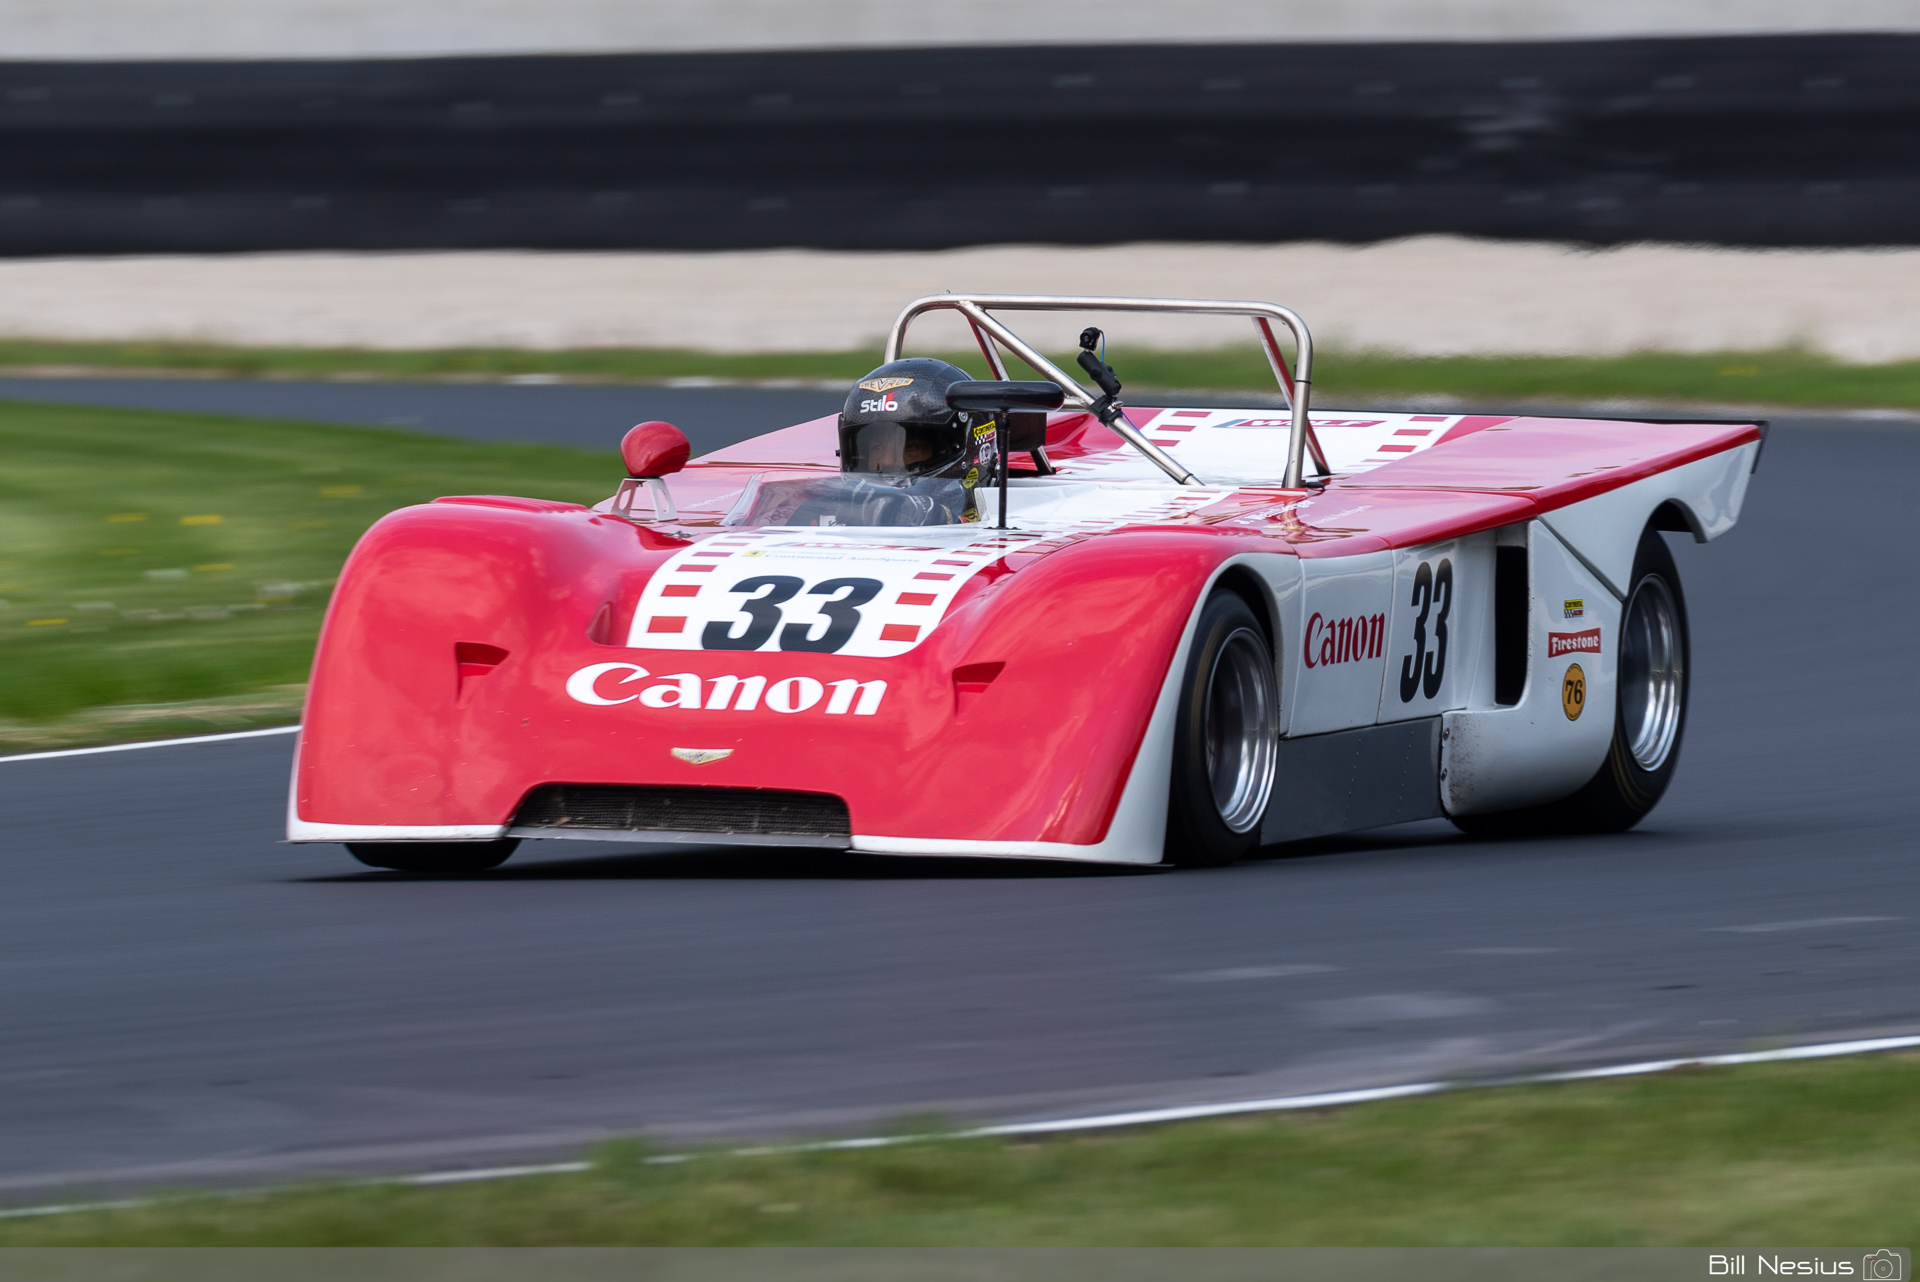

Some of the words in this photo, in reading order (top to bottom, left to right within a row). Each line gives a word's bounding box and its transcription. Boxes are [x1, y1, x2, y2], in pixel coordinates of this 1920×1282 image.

[701, 575, 884, 654] 33
[1303, 612, 1385, 669] Canon
[1400, 558, 1453, 703] 33
[1551, 635, 1599, 655] Firestone
[565, 662, 888, 715] Canon
[1565, 679, 1583, 704] 76
